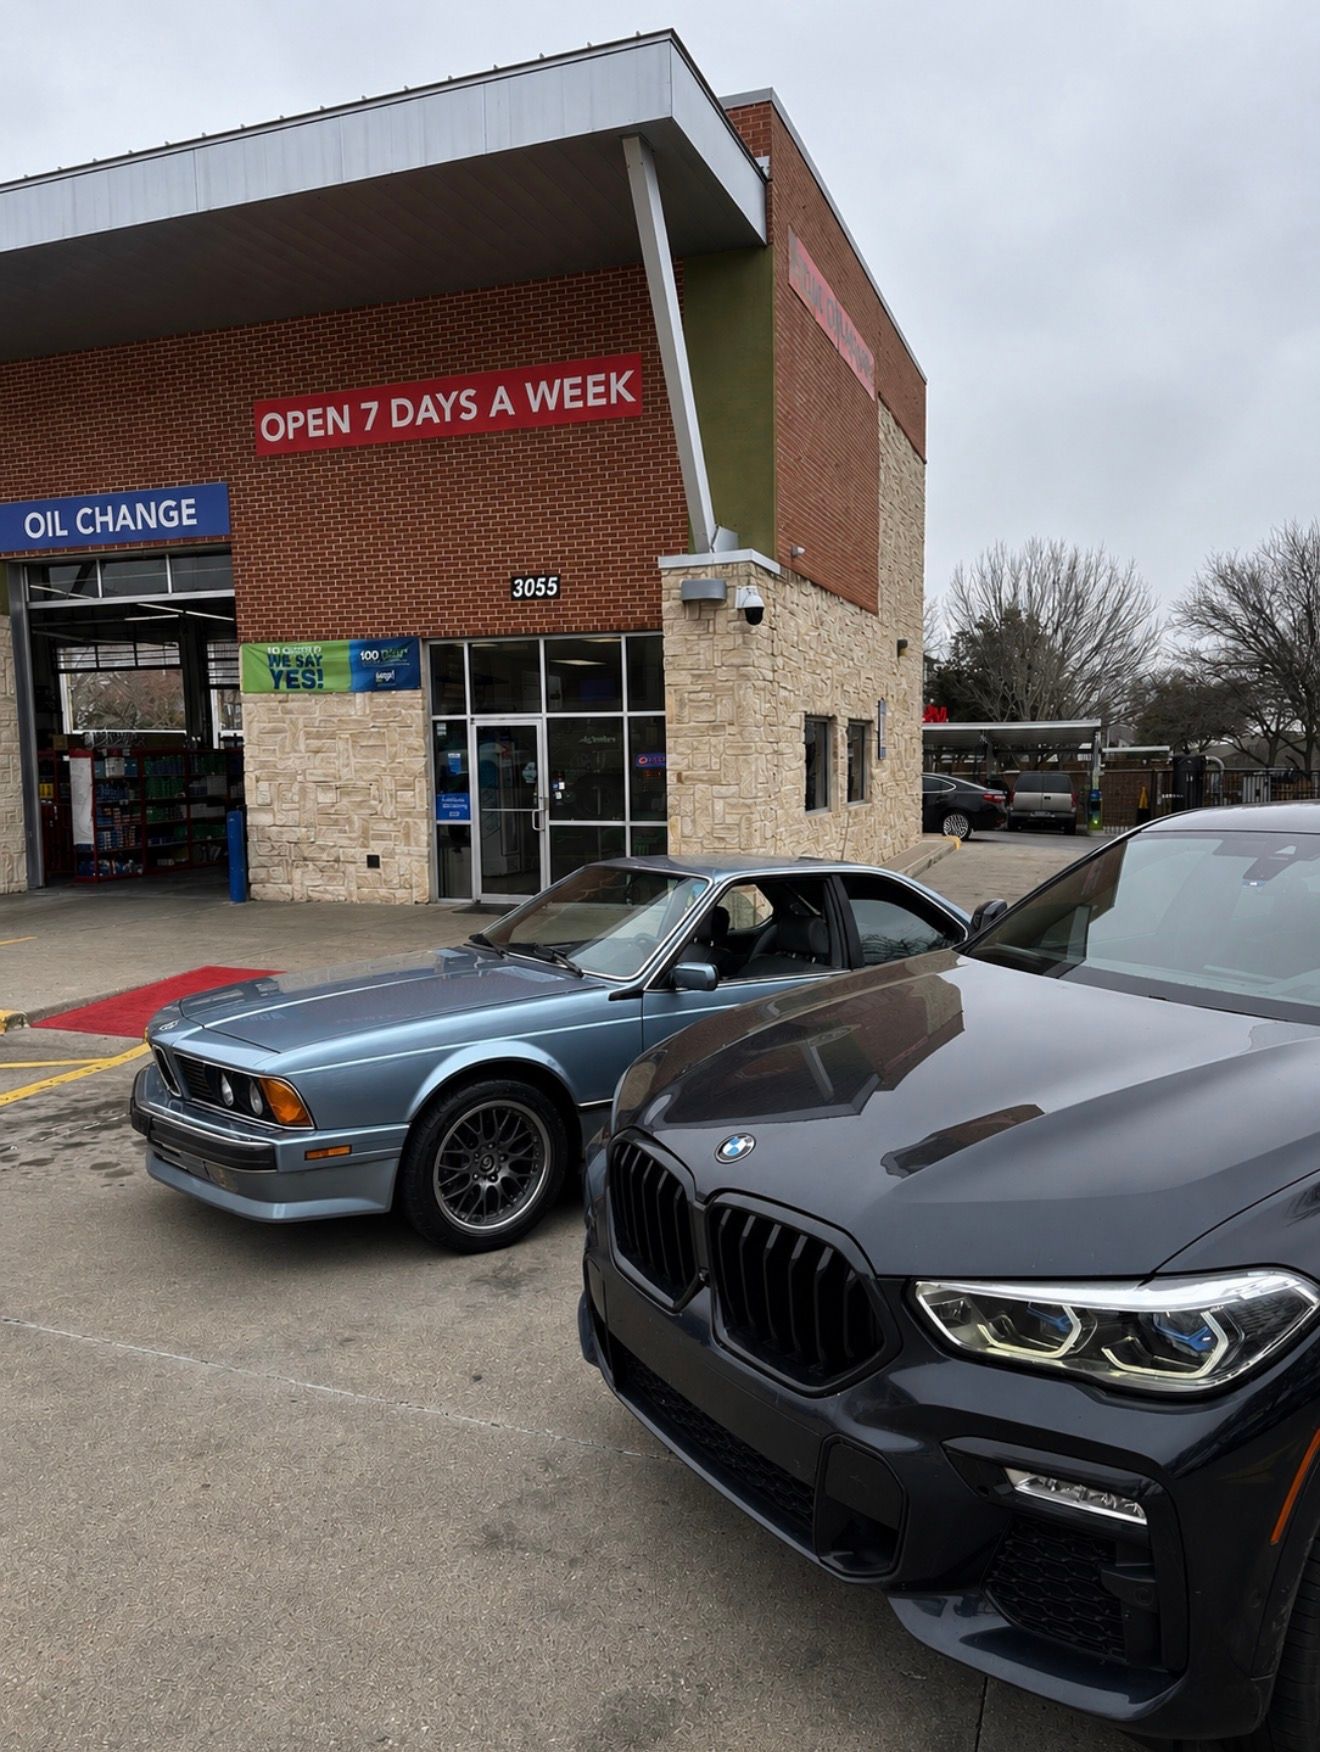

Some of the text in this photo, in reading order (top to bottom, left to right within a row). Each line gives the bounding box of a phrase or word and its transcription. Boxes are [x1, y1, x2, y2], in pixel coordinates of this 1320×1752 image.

[260, 369, 637, 442] OPEN 7 DAYS A WEEK
[24, 498, 198, 539] OIL CHANGE
[512, 576, 558, 598] 3055
[267, 654, 323, 667] WE SAY
[360, 649, 379, 661] 100
[270, 669, 323, 689] YES!
